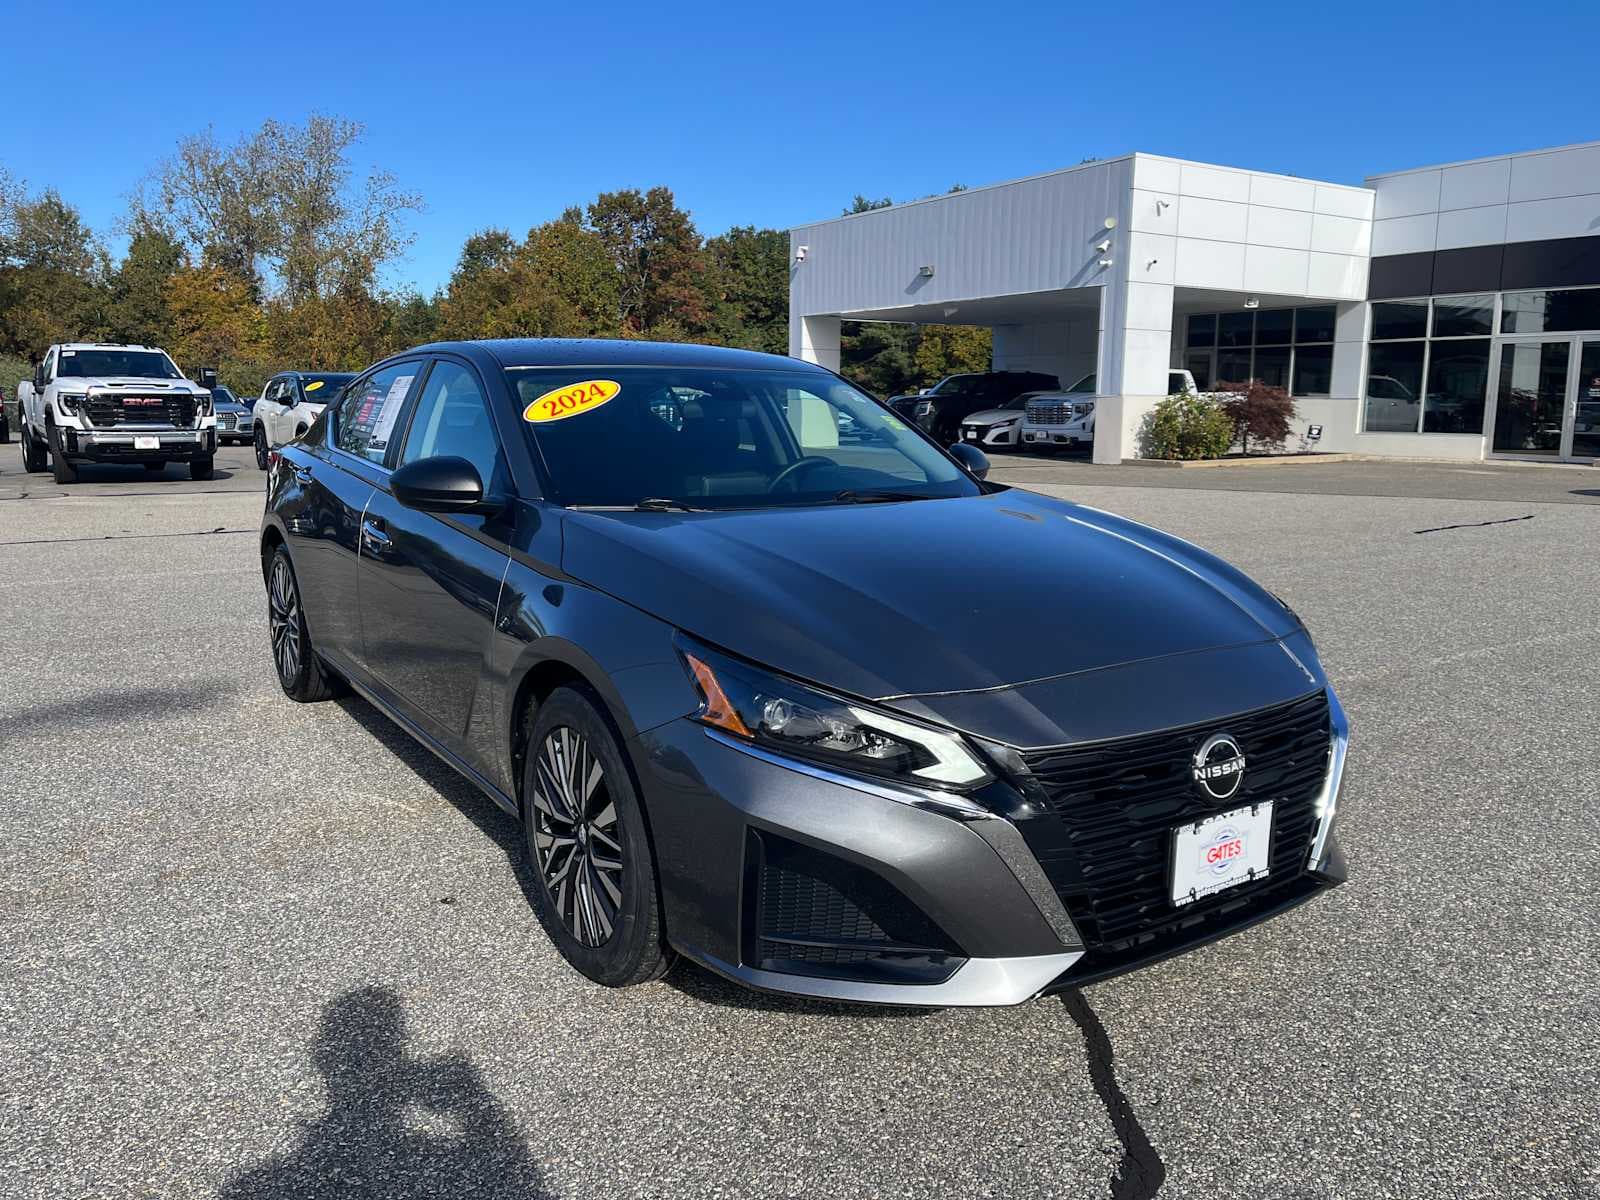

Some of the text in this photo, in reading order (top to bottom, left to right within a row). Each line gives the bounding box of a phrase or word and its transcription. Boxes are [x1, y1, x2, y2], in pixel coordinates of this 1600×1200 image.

[123, 398, 163, 406] GMC
[543, 383, 606, 417] 2024
[1194, 757, 1246, 780] NISSAN
[1207, 840, 1242, 863] GATES
